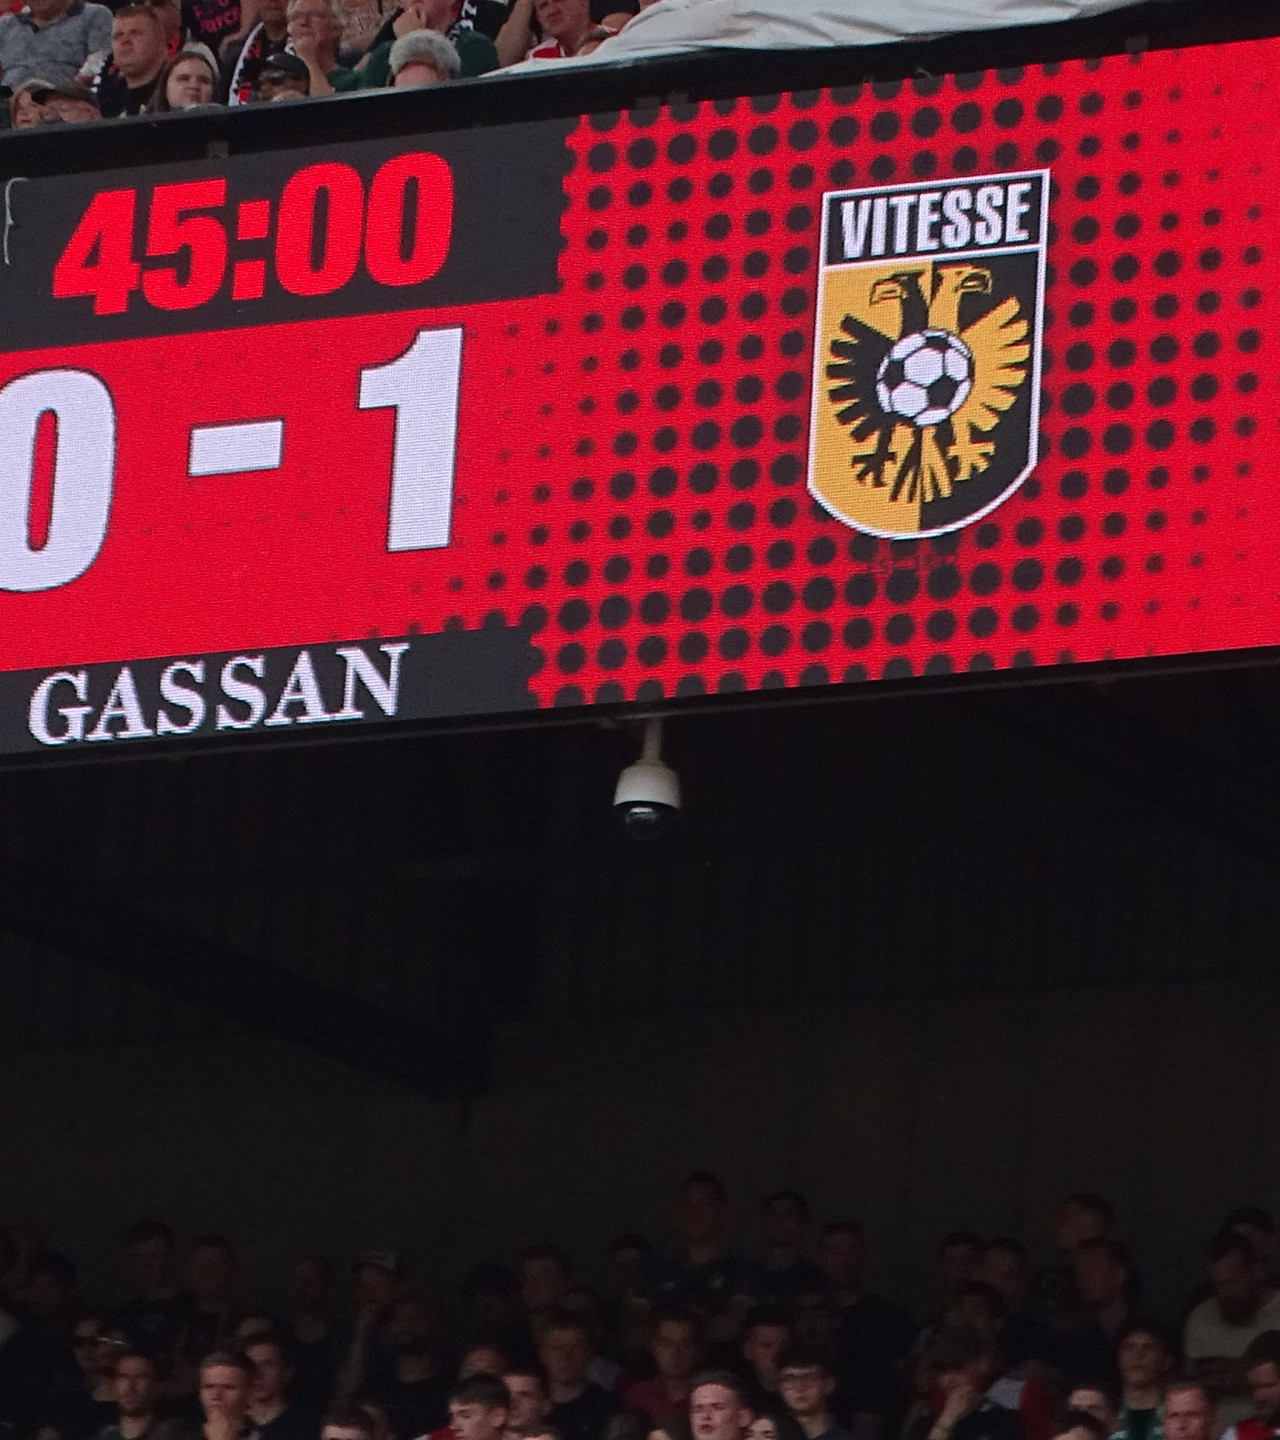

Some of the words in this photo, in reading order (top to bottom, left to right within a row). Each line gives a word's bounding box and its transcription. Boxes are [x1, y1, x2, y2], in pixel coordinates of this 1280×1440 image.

[51, 151, 454, 316] 45:00
[839, 181, 1033, 260] VITESSE
[357, 324, 463, 553] 1
[28, 642, 410, 747] GASSAN
